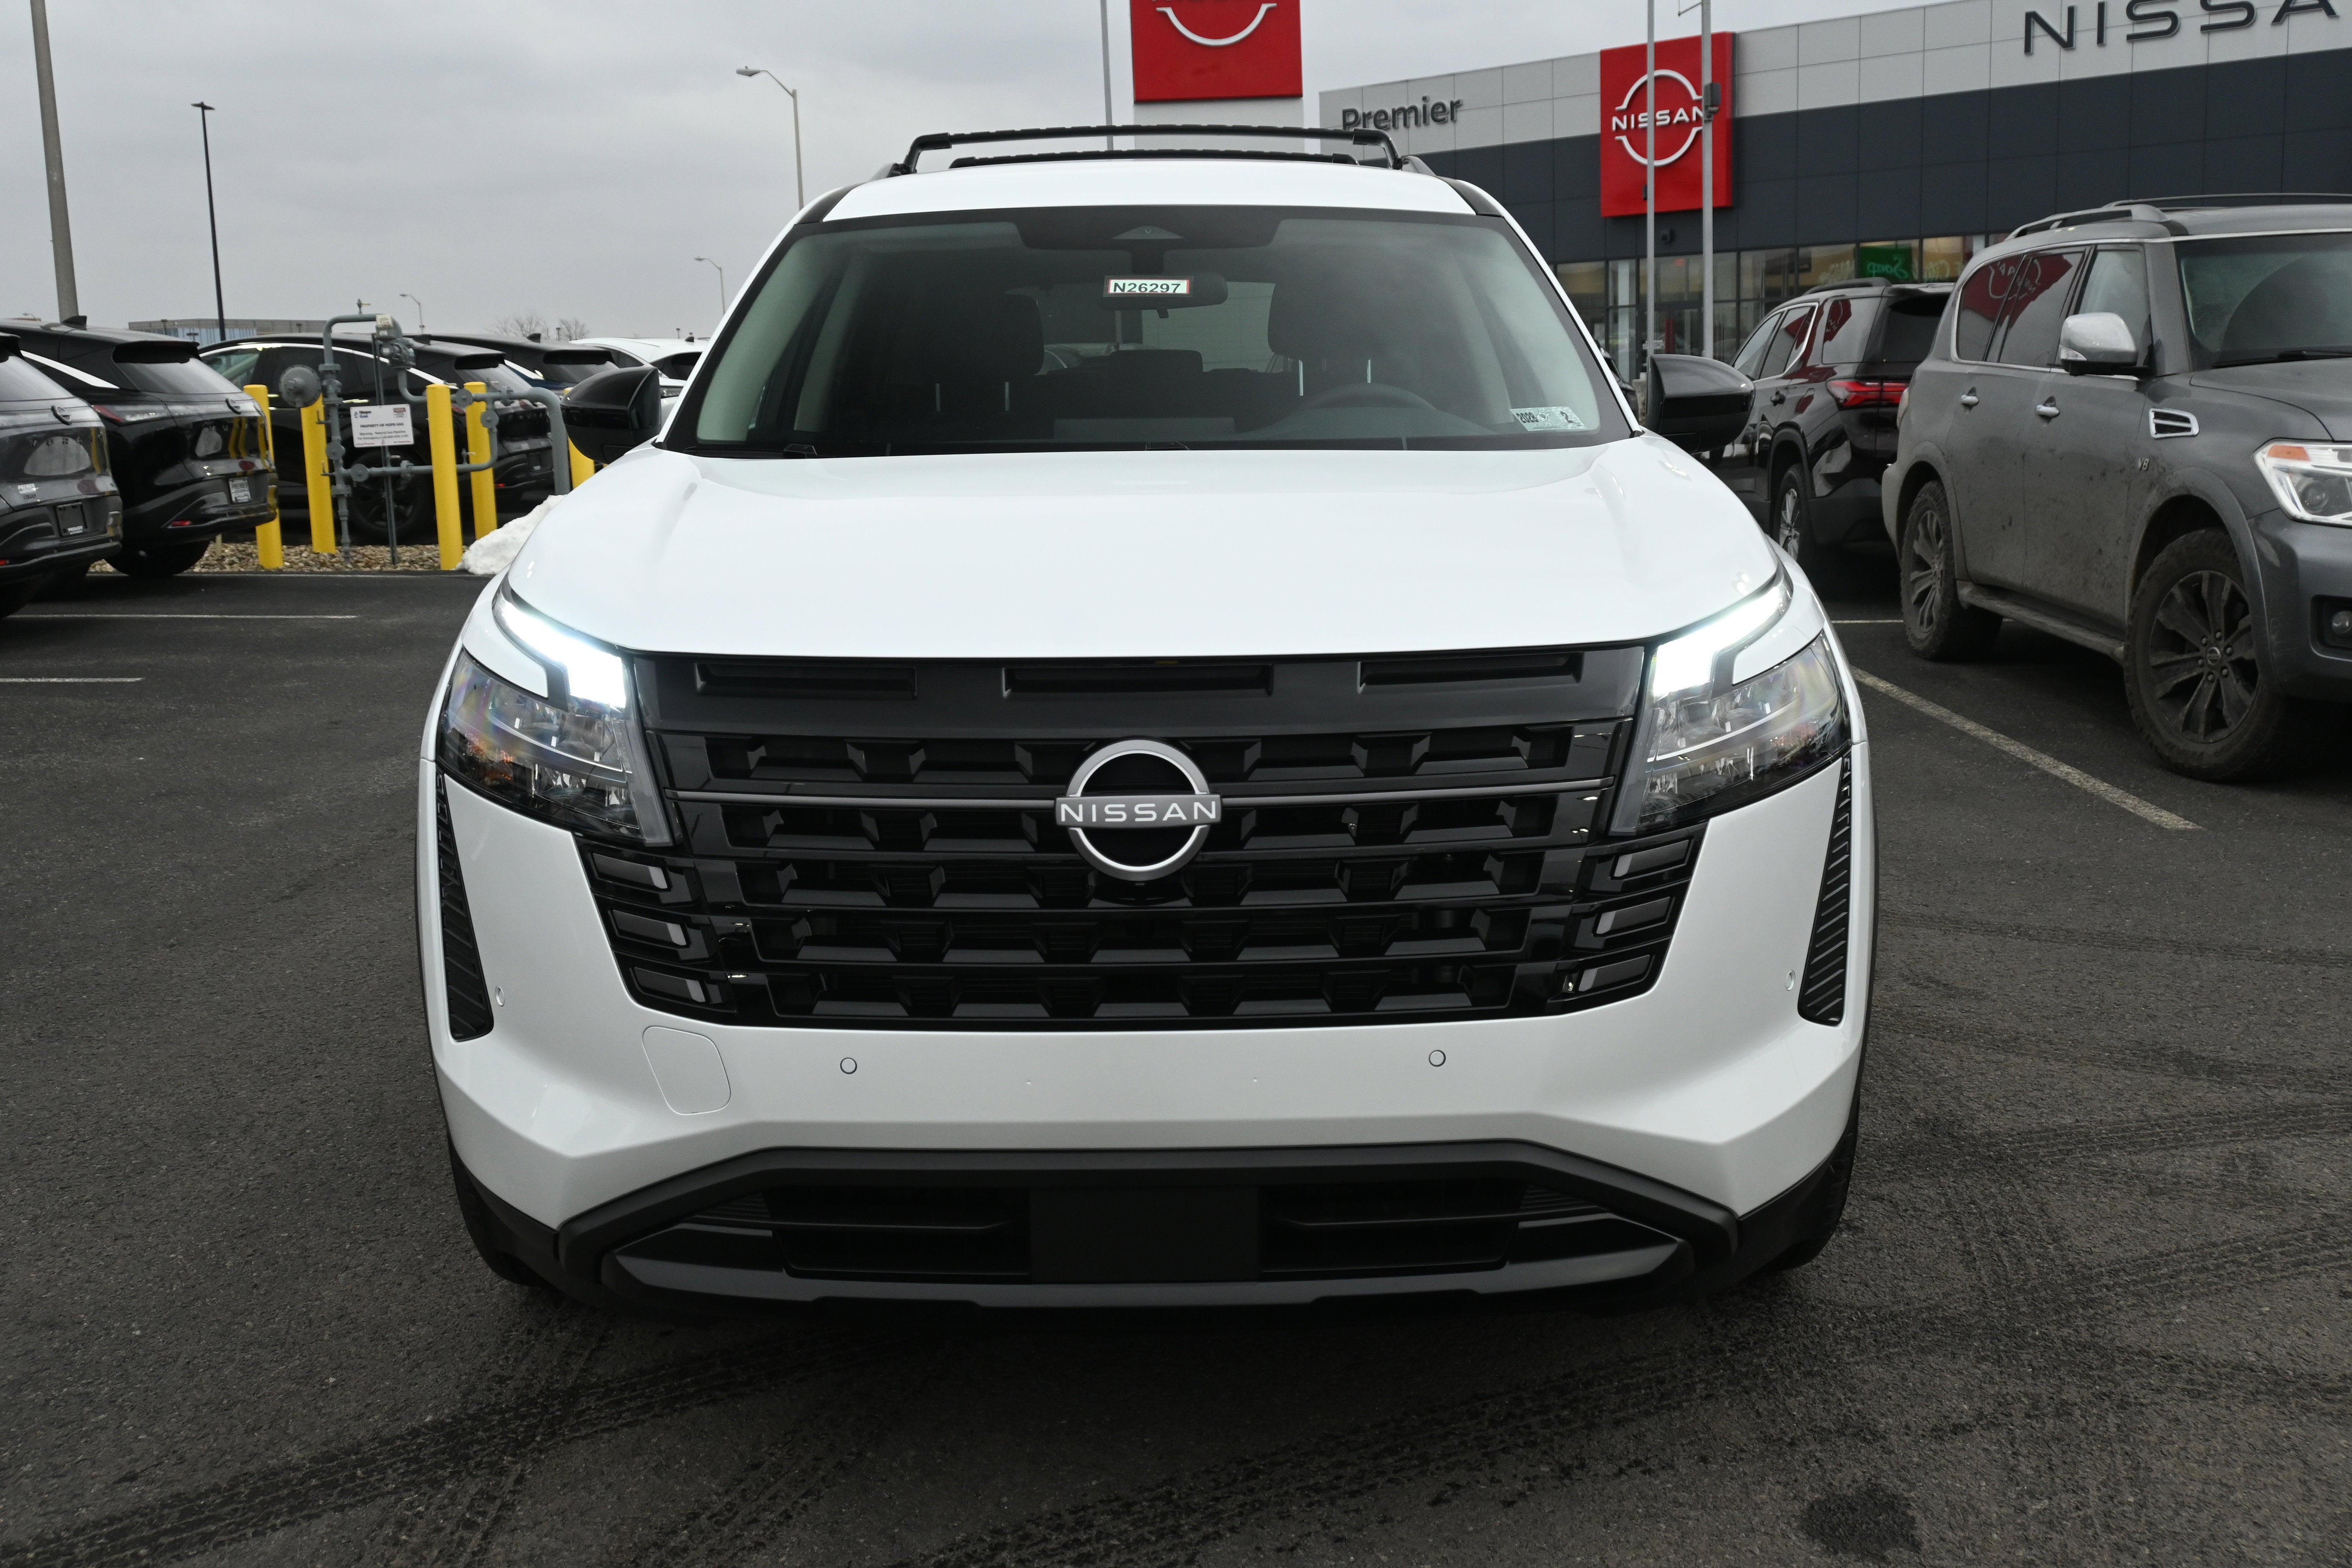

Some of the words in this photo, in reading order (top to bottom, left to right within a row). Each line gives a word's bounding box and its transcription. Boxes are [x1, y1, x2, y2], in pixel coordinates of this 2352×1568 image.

[1342, 95, 1462, 130] Premier
[1113, 283, 1181, 293] N26297
[1516, 412, 1539, 423] 2028
[1560, 411, 1574, 423] 2
[30, 434, 103, 447] MURAO
[2138, 458, 2149, 470] V8
[1060, 801, 1216, 822] NISSAN
